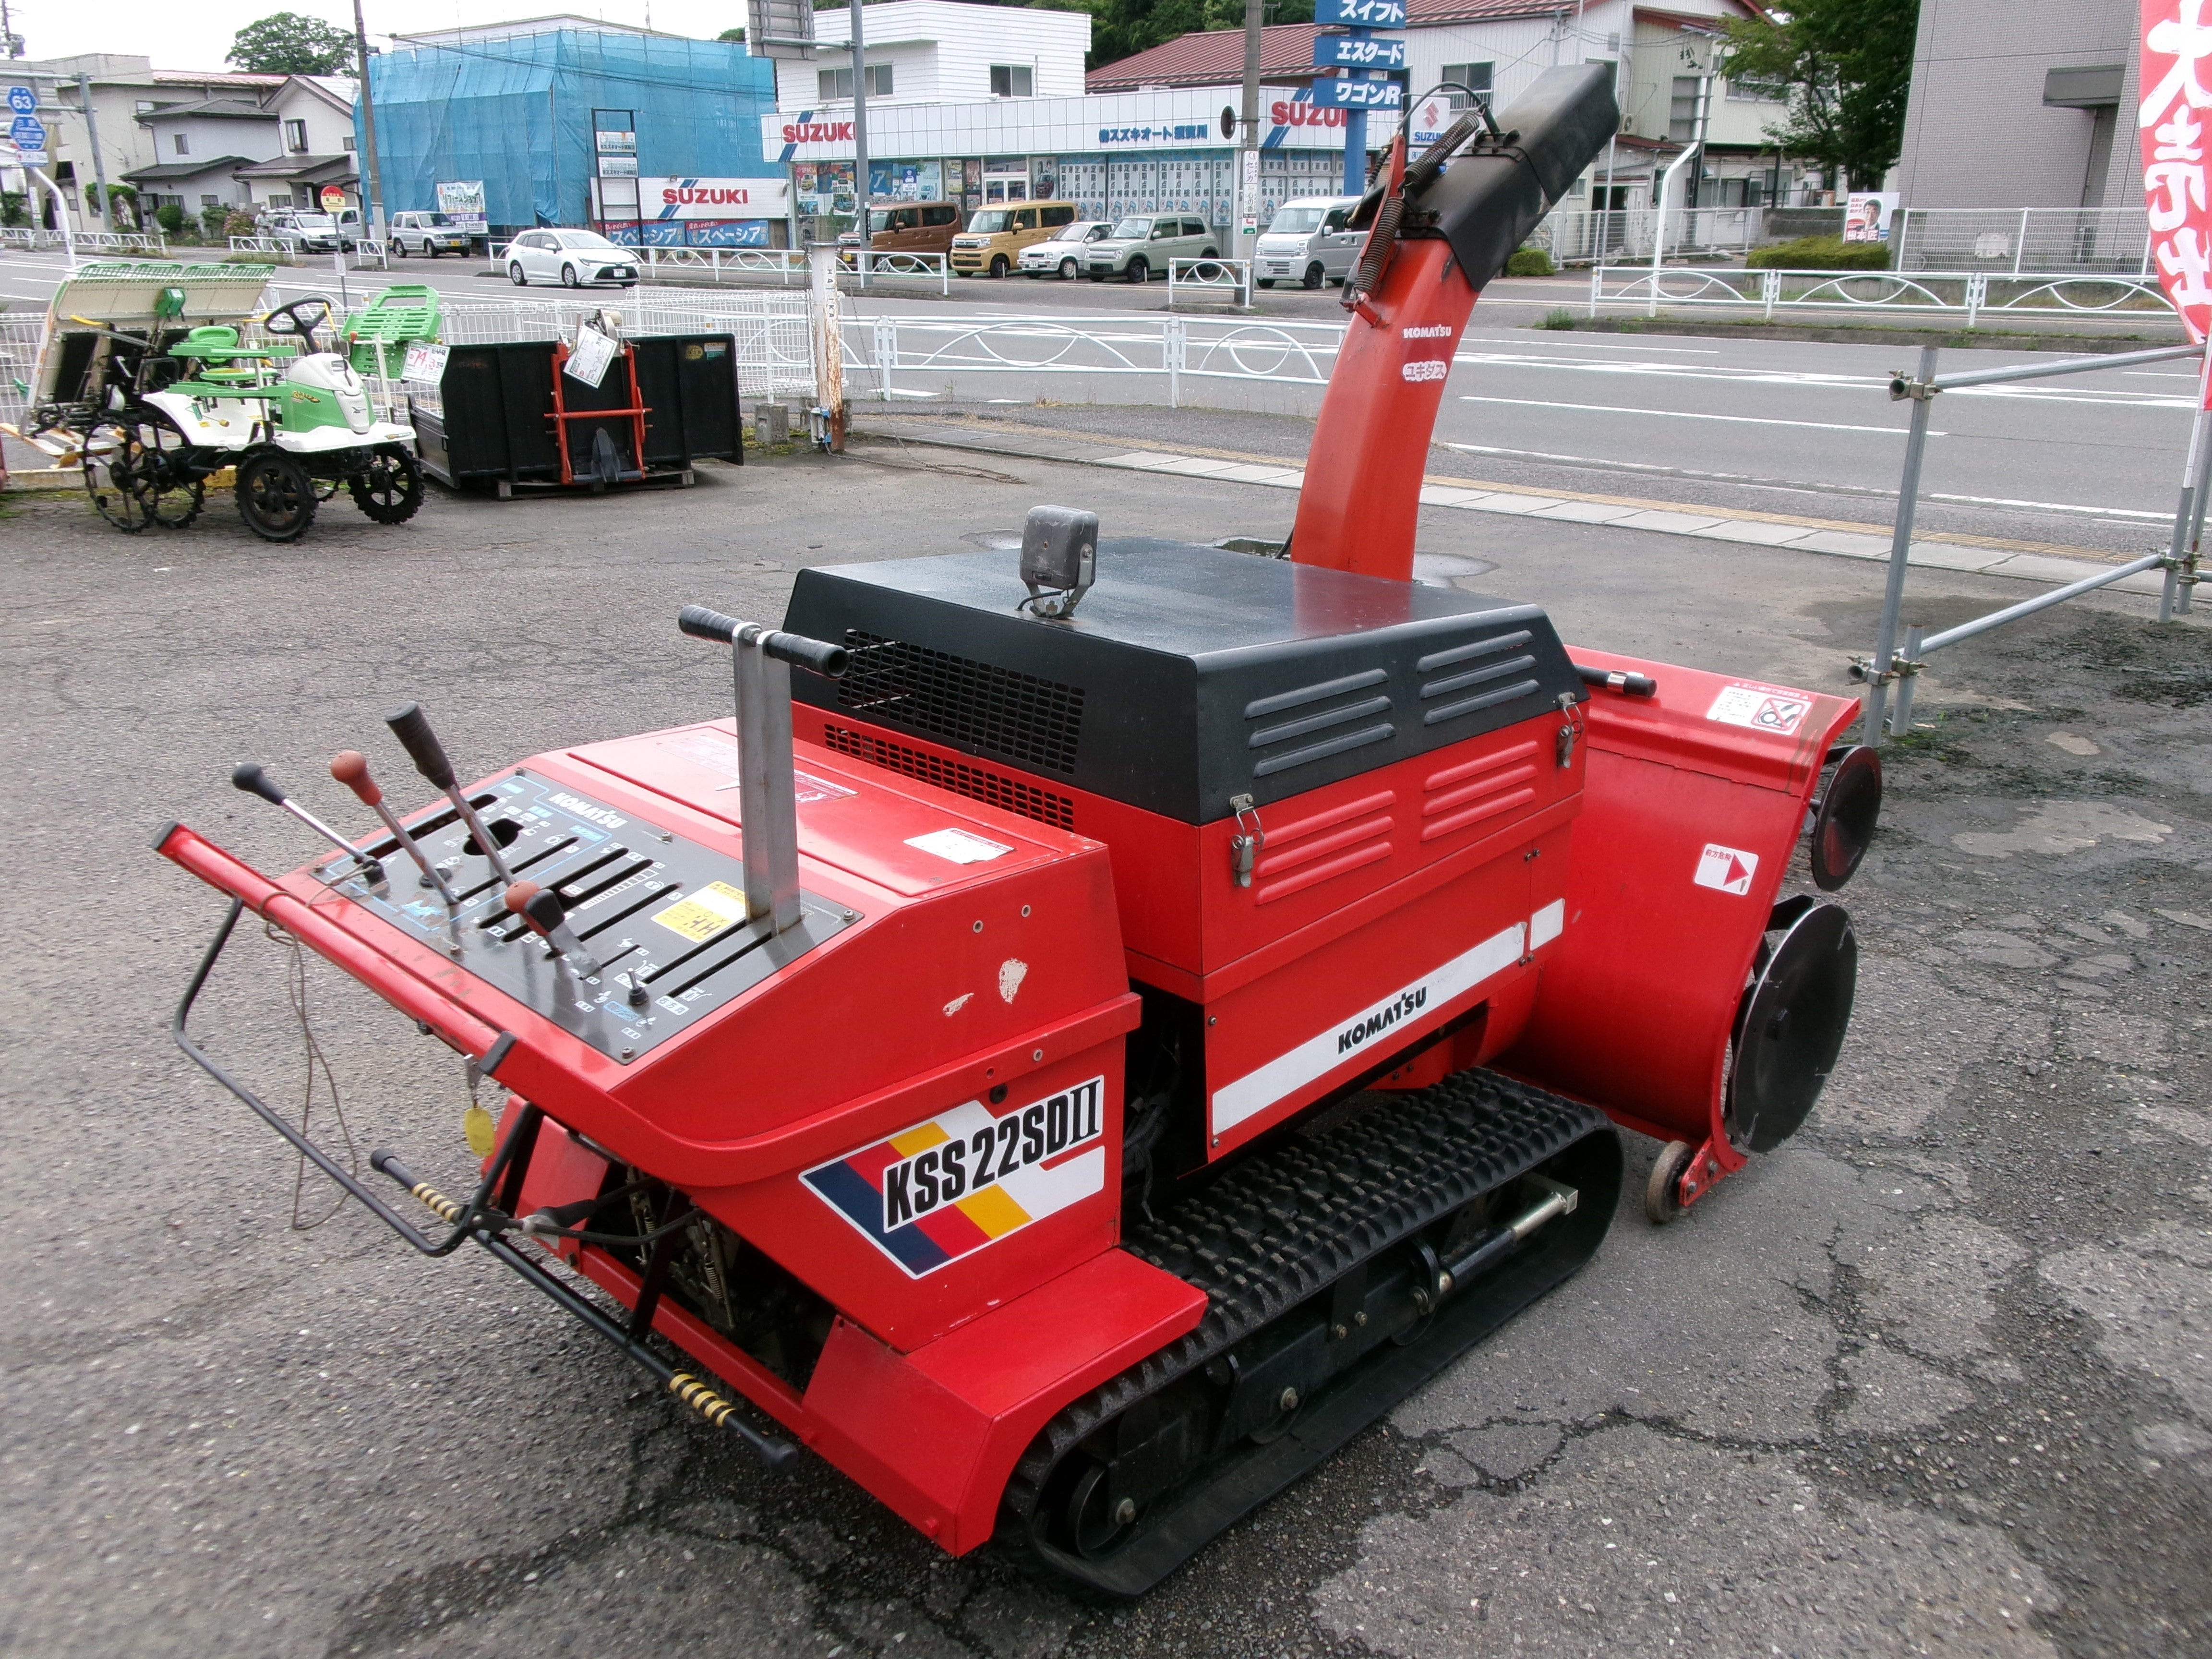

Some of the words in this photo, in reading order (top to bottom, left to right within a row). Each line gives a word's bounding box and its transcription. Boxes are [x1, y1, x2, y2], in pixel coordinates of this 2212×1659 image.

[1339, 0, 1404, 22] スイフト
[1336, 41, 1404, 64] エスクード
[12, 95, 33, 109] 63
[1335, 83, 1401, 105] ワゴンR
[662, 188, 748, 204] SUZUKI
[699, 227, 761, 244] スペーシア
[1403, 324, 1452, 338] KOMATSU
[1406, 364, 1444, 378] ユキダス
[548, 792, 628, 829] KOMATSU
[1705, 849, 1732, 862] 前方危険
[659, 998, 685, 1014] 右方向
[1338, 986, 1427, 1055] KOMATSU
